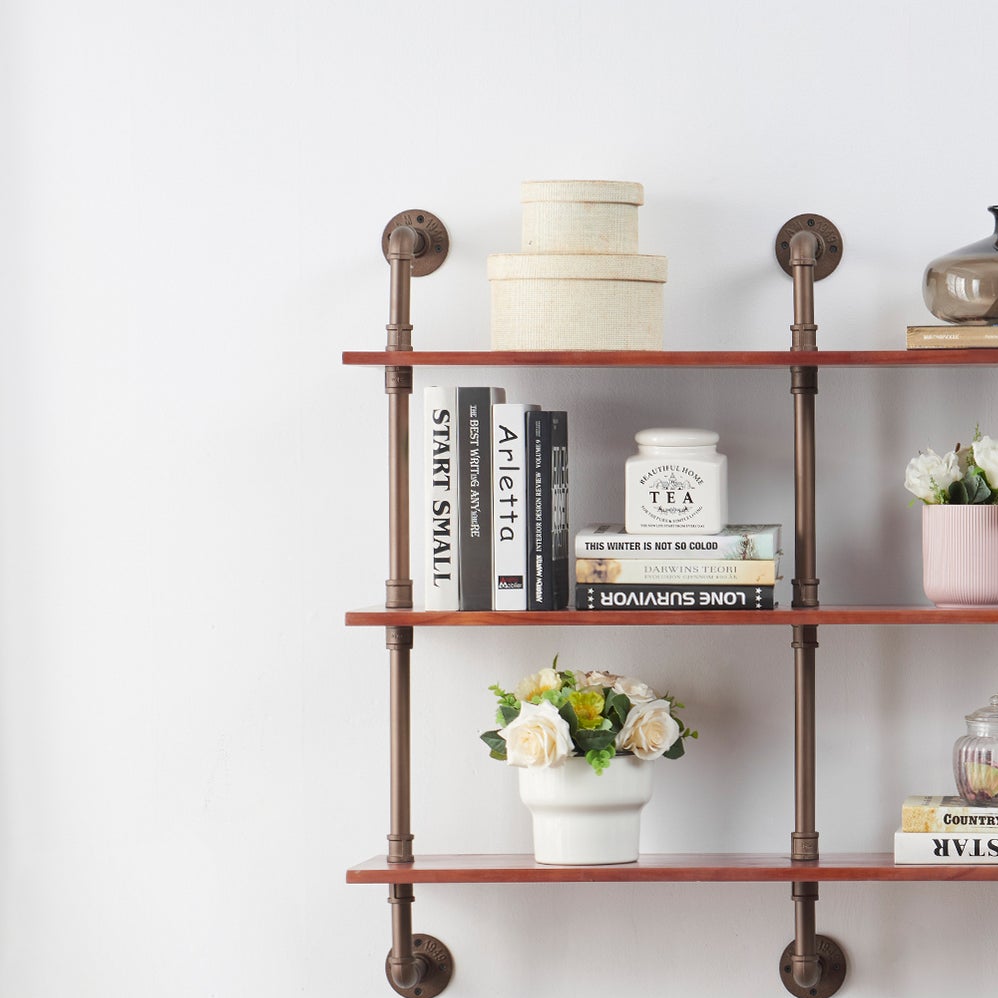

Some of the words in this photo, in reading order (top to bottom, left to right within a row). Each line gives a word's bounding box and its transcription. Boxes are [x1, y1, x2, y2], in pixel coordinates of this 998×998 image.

[469, 404, 477, 418] THE
[469, 419, 480, 447] BEST
[432, 409, 451, 492] START
[535, 444, 543, 469] VOLUME
[498, 425, 520, 542] Arletta
[535, 471, 543, 496] REVIEW
[640, 465, 680, 485] BEAUTIFUL
[681, 466, 704, 486] HOME
[649, 491, 694, 504] TEA
[535, 497, 543, 522] DESIGN
[432, 500, 451, 588] SMALL
[535, 522, 543, 552] INTERIOR
[585, 542, 605, 551] THIS
[607, 542, 641, 551] WINTER
[643, 542, 652, 551] IS
[654, 542, 673, 550] NOT
[675, 542, 687, 550] SO
[689, 541, 718, 550] COLOD
[644, 565, 699, 574] DARWINS
[702, 565, 737, 574] TEORI
[600, 591, 695, 606] SURVIVOR
[699, 591, 746, 606] LONE
[424, 940, 447, 962] 1949
